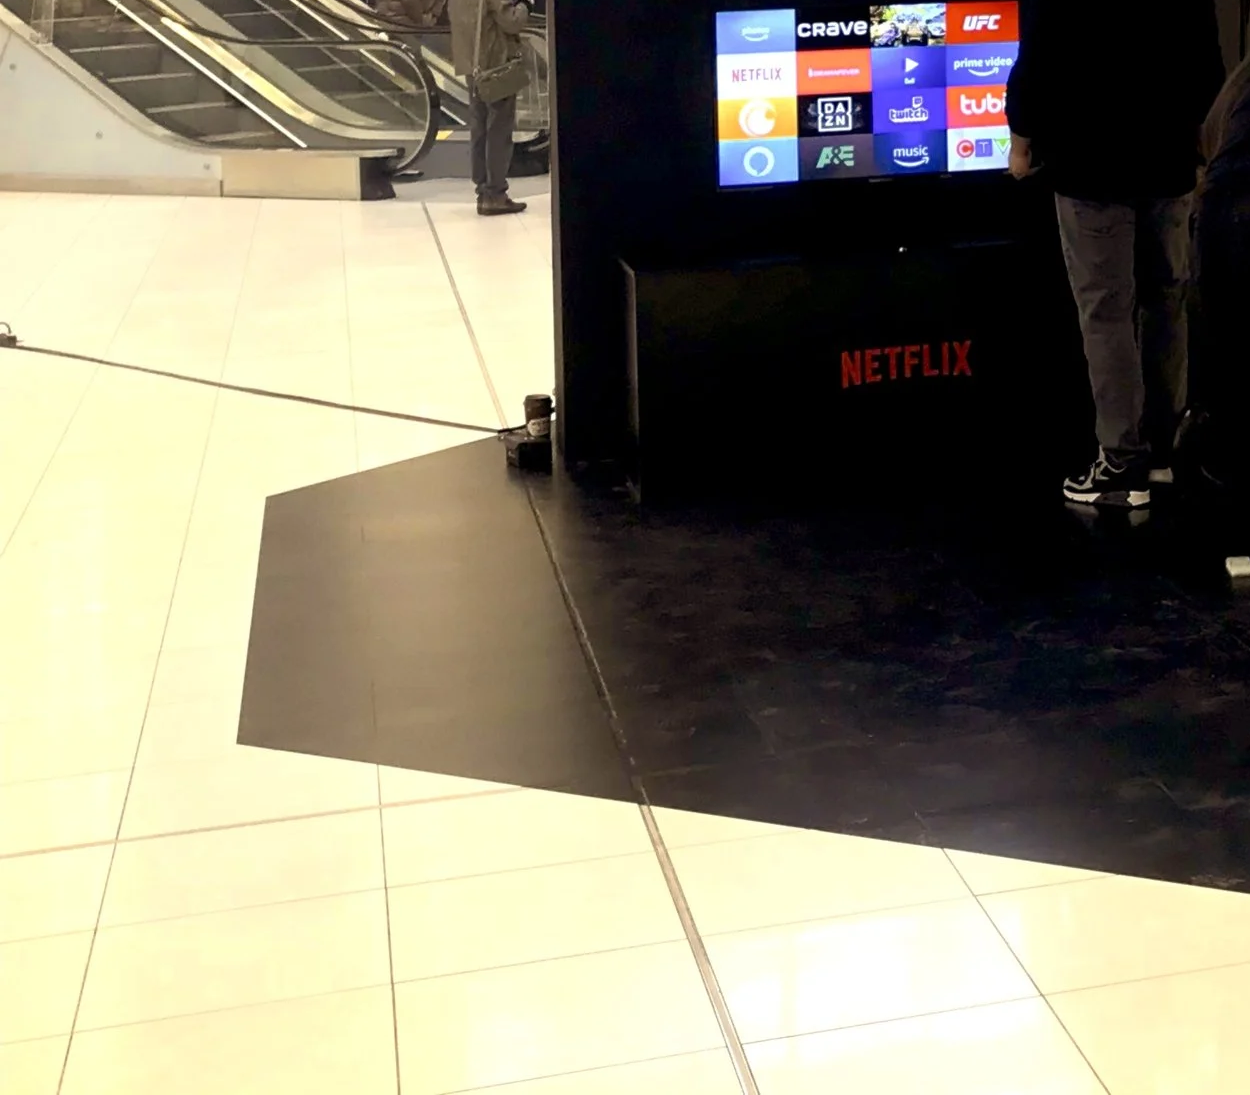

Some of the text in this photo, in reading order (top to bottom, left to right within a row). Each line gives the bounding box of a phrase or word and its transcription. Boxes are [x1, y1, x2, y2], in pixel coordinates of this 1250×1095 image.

[962, 14, 1002, 31] UFC
[953, 56, 1013, 71] prime video
[731, 68, 782, 83] NETFLIX
[959, 92, 1007, 115] tubi
[889, 107, 928, 122] twitch
[816, 145, 855, 169] A&E
[893, 145, 929, 157] music
[841, 339, 972, 389] NETFLIX
